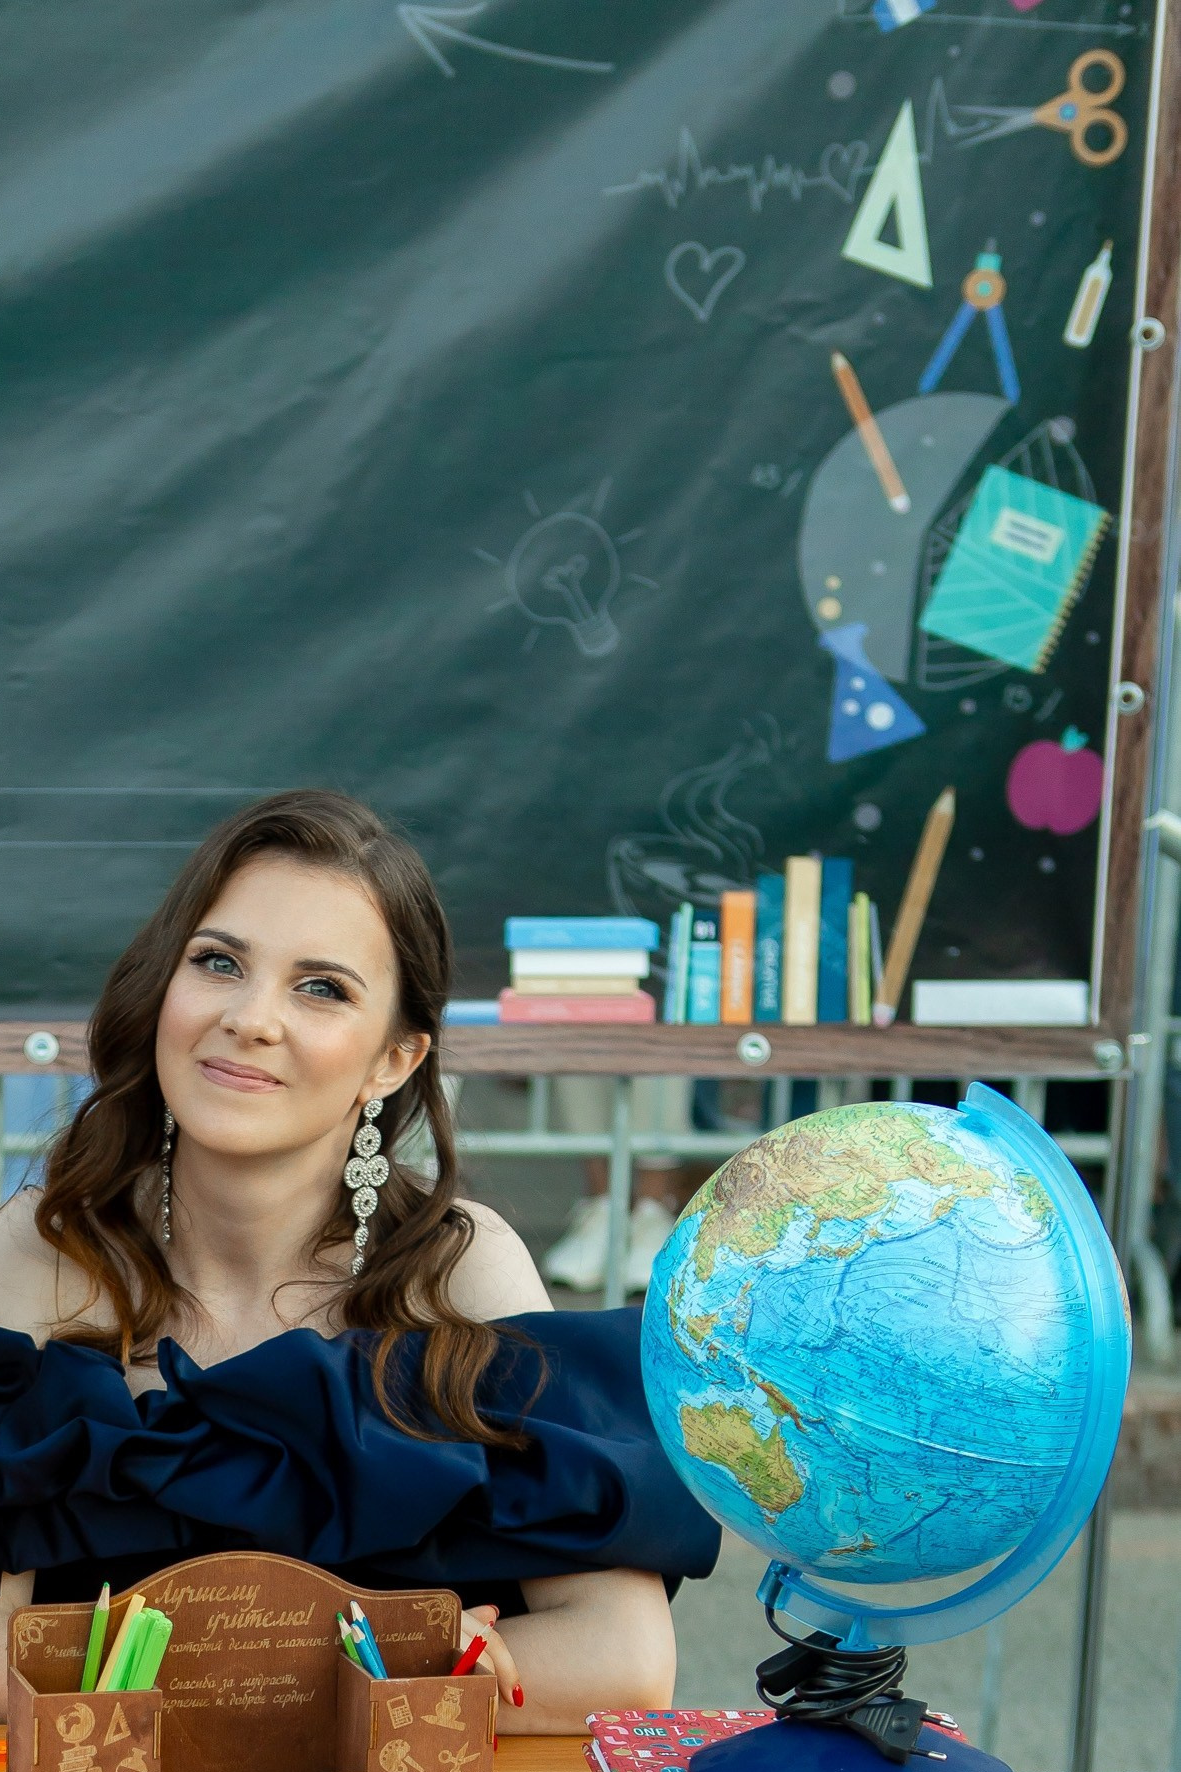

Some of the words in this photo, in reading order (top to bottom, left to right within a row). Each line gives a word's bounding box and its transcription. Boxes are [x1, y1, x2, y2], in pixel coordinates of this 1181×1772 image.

[154, 1579, 261, 1616] Лучшему
[200, 1601, 317, 1642] учителю!
[43, 1645, 87, 1659] Учите
[228, 1637, 271, 1651] делает
[275, 1636, 329, 1649] сложные
[169, 1673, 217, 1691] Спасибо
[218, 1679, 236, 1694] за
[239, 1673, 301, 1692] мудрость,
[215, 1696, 225, 1707] и
[229, 1688, 267, 1711] доброе
[272, 1688, 316, 1709] сердце!
[632, 1726, 668, 1737] ONE
